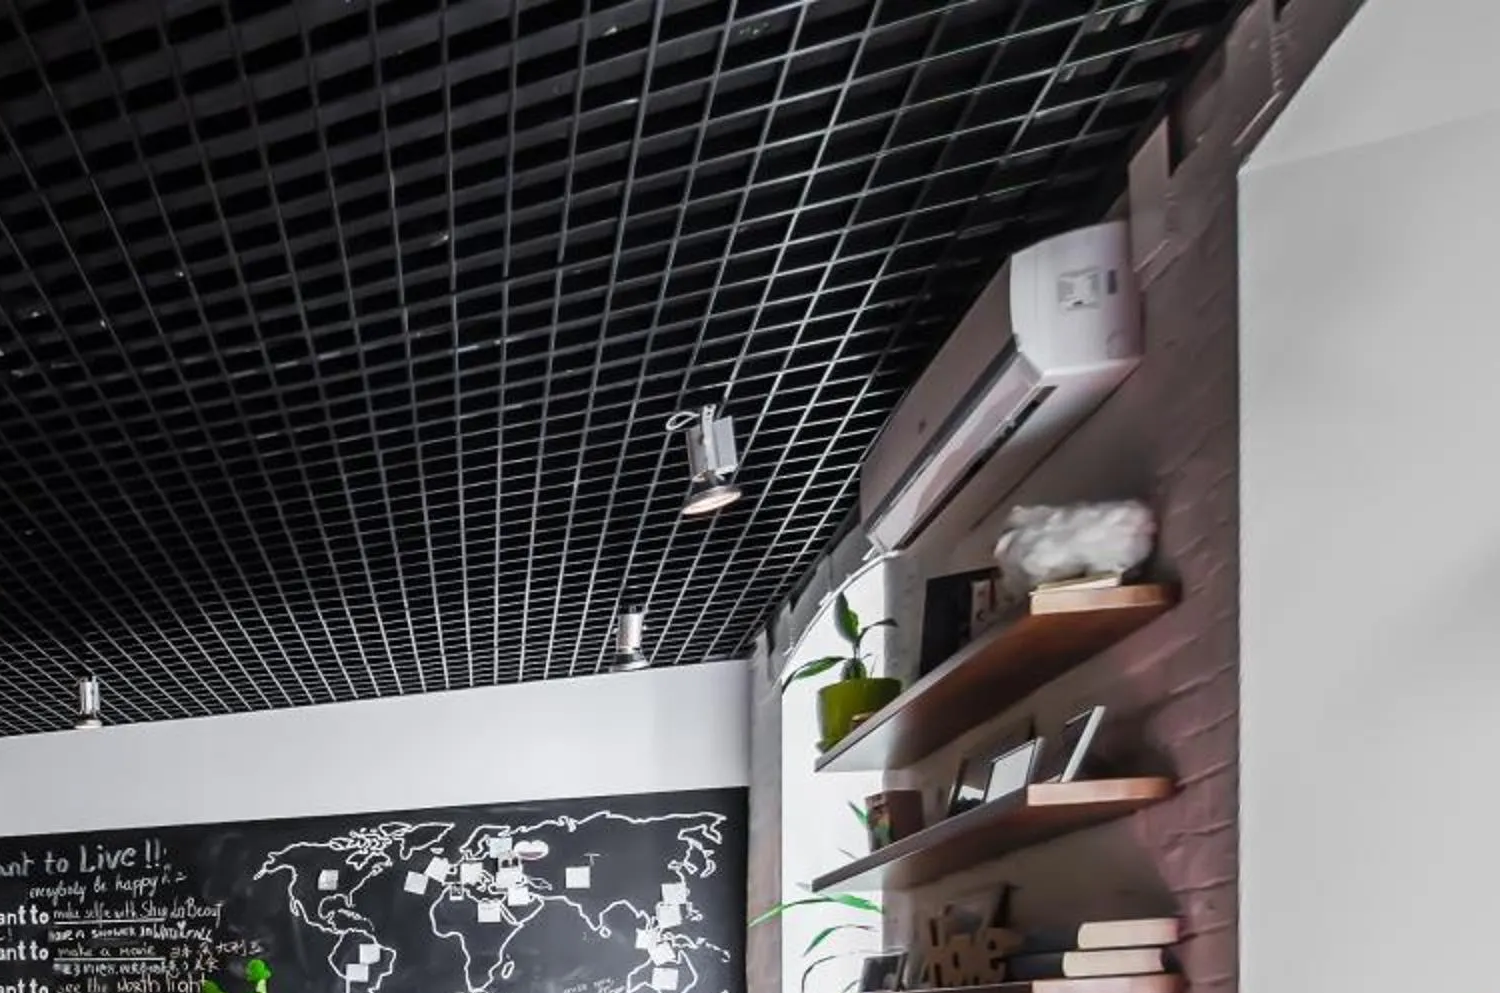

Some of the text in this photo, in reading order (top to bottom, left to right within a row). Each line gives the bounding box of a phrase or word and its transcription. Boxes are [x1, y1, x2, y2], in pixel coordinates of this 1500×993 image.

[44, 852, 70, 874] to
[79, 845, 137, 873] Live
[115, 873, 159, 897] happy
[29, 904, 50, 925] to
[29, 940, 49, 960] to
